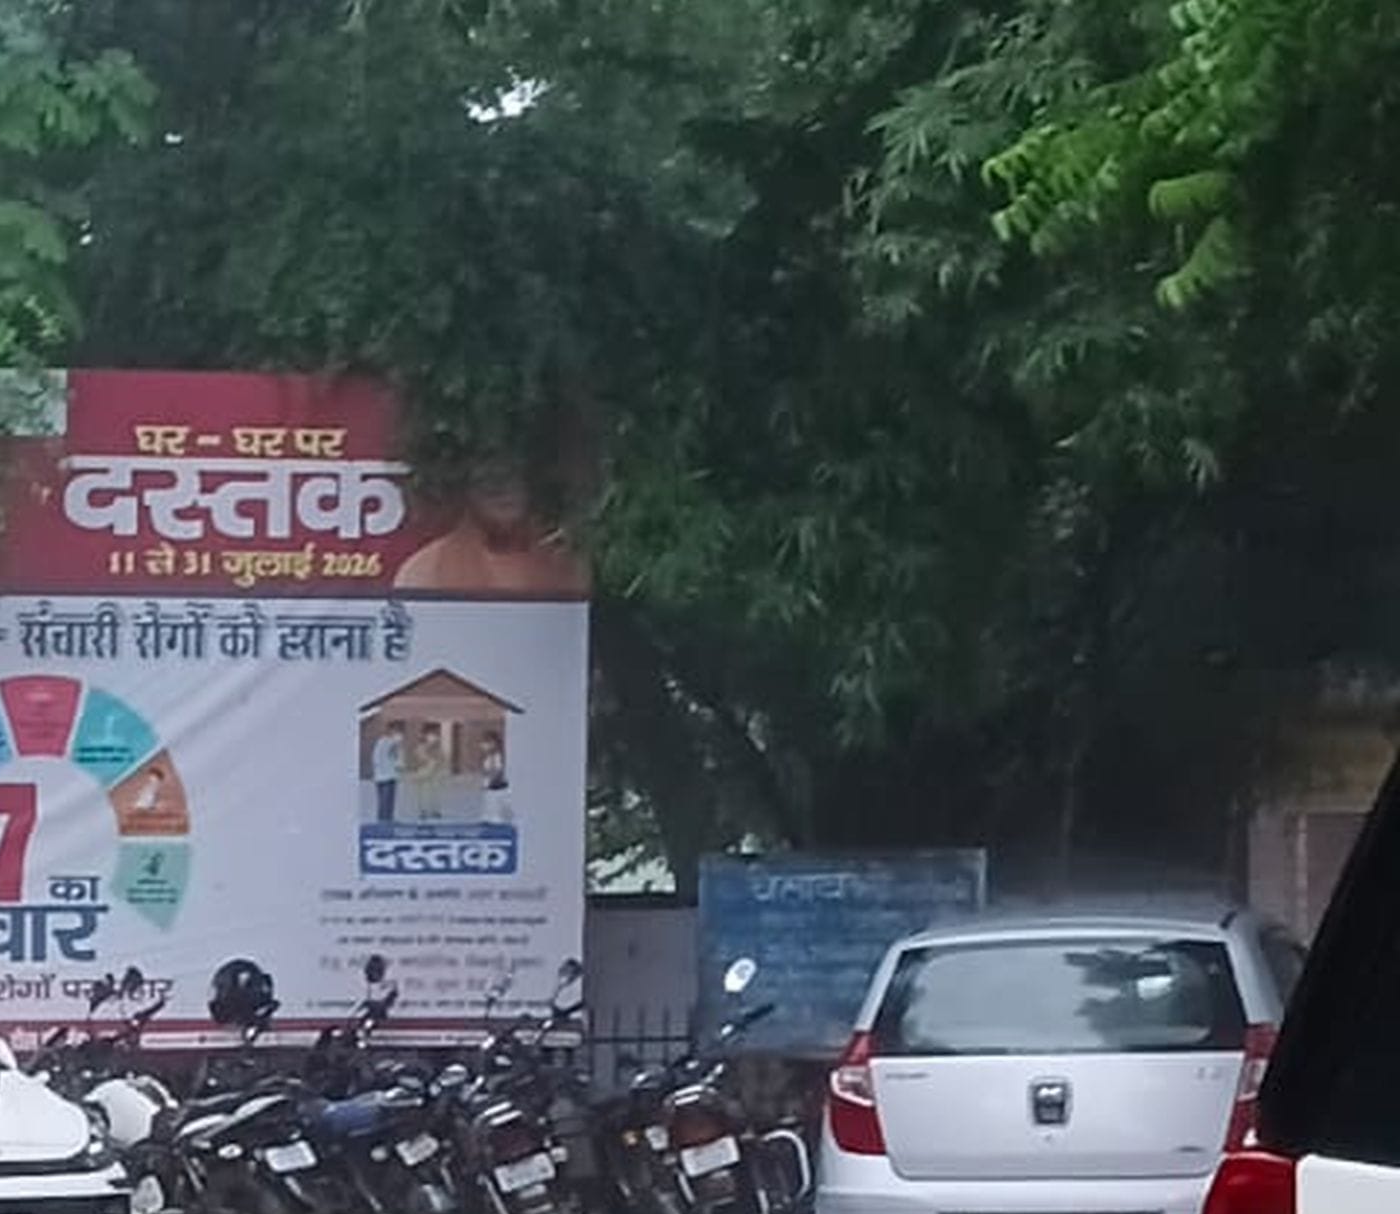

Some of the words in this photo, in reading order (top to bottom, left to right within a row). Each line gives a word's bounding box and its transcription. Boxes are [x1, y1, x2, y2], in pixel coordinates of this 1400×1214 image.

[135, 425, 190, 455] घर
[232, 427, 288, 457] घर
[294, 428, 347, 457] पर
[61, 455, 414, 541] दस्तक
[109, 551, 134, 574] 11
[145, 542, 175, 575] से
[183, 550, 210, 575] 31
[222, 543, 316, 587] जुलाई
[321, 551, 382, 576] 2026
[18, 601, 118, 660] संचारी
[132, 600, 210, 661] रोगों
[215, 602, 267, 661] को
[276, 613, 377, 662] हराना
[379, 600, 414, 662] है
[363, 838, 513, 871] दस्तक
[47, 876, 101, 902] का
